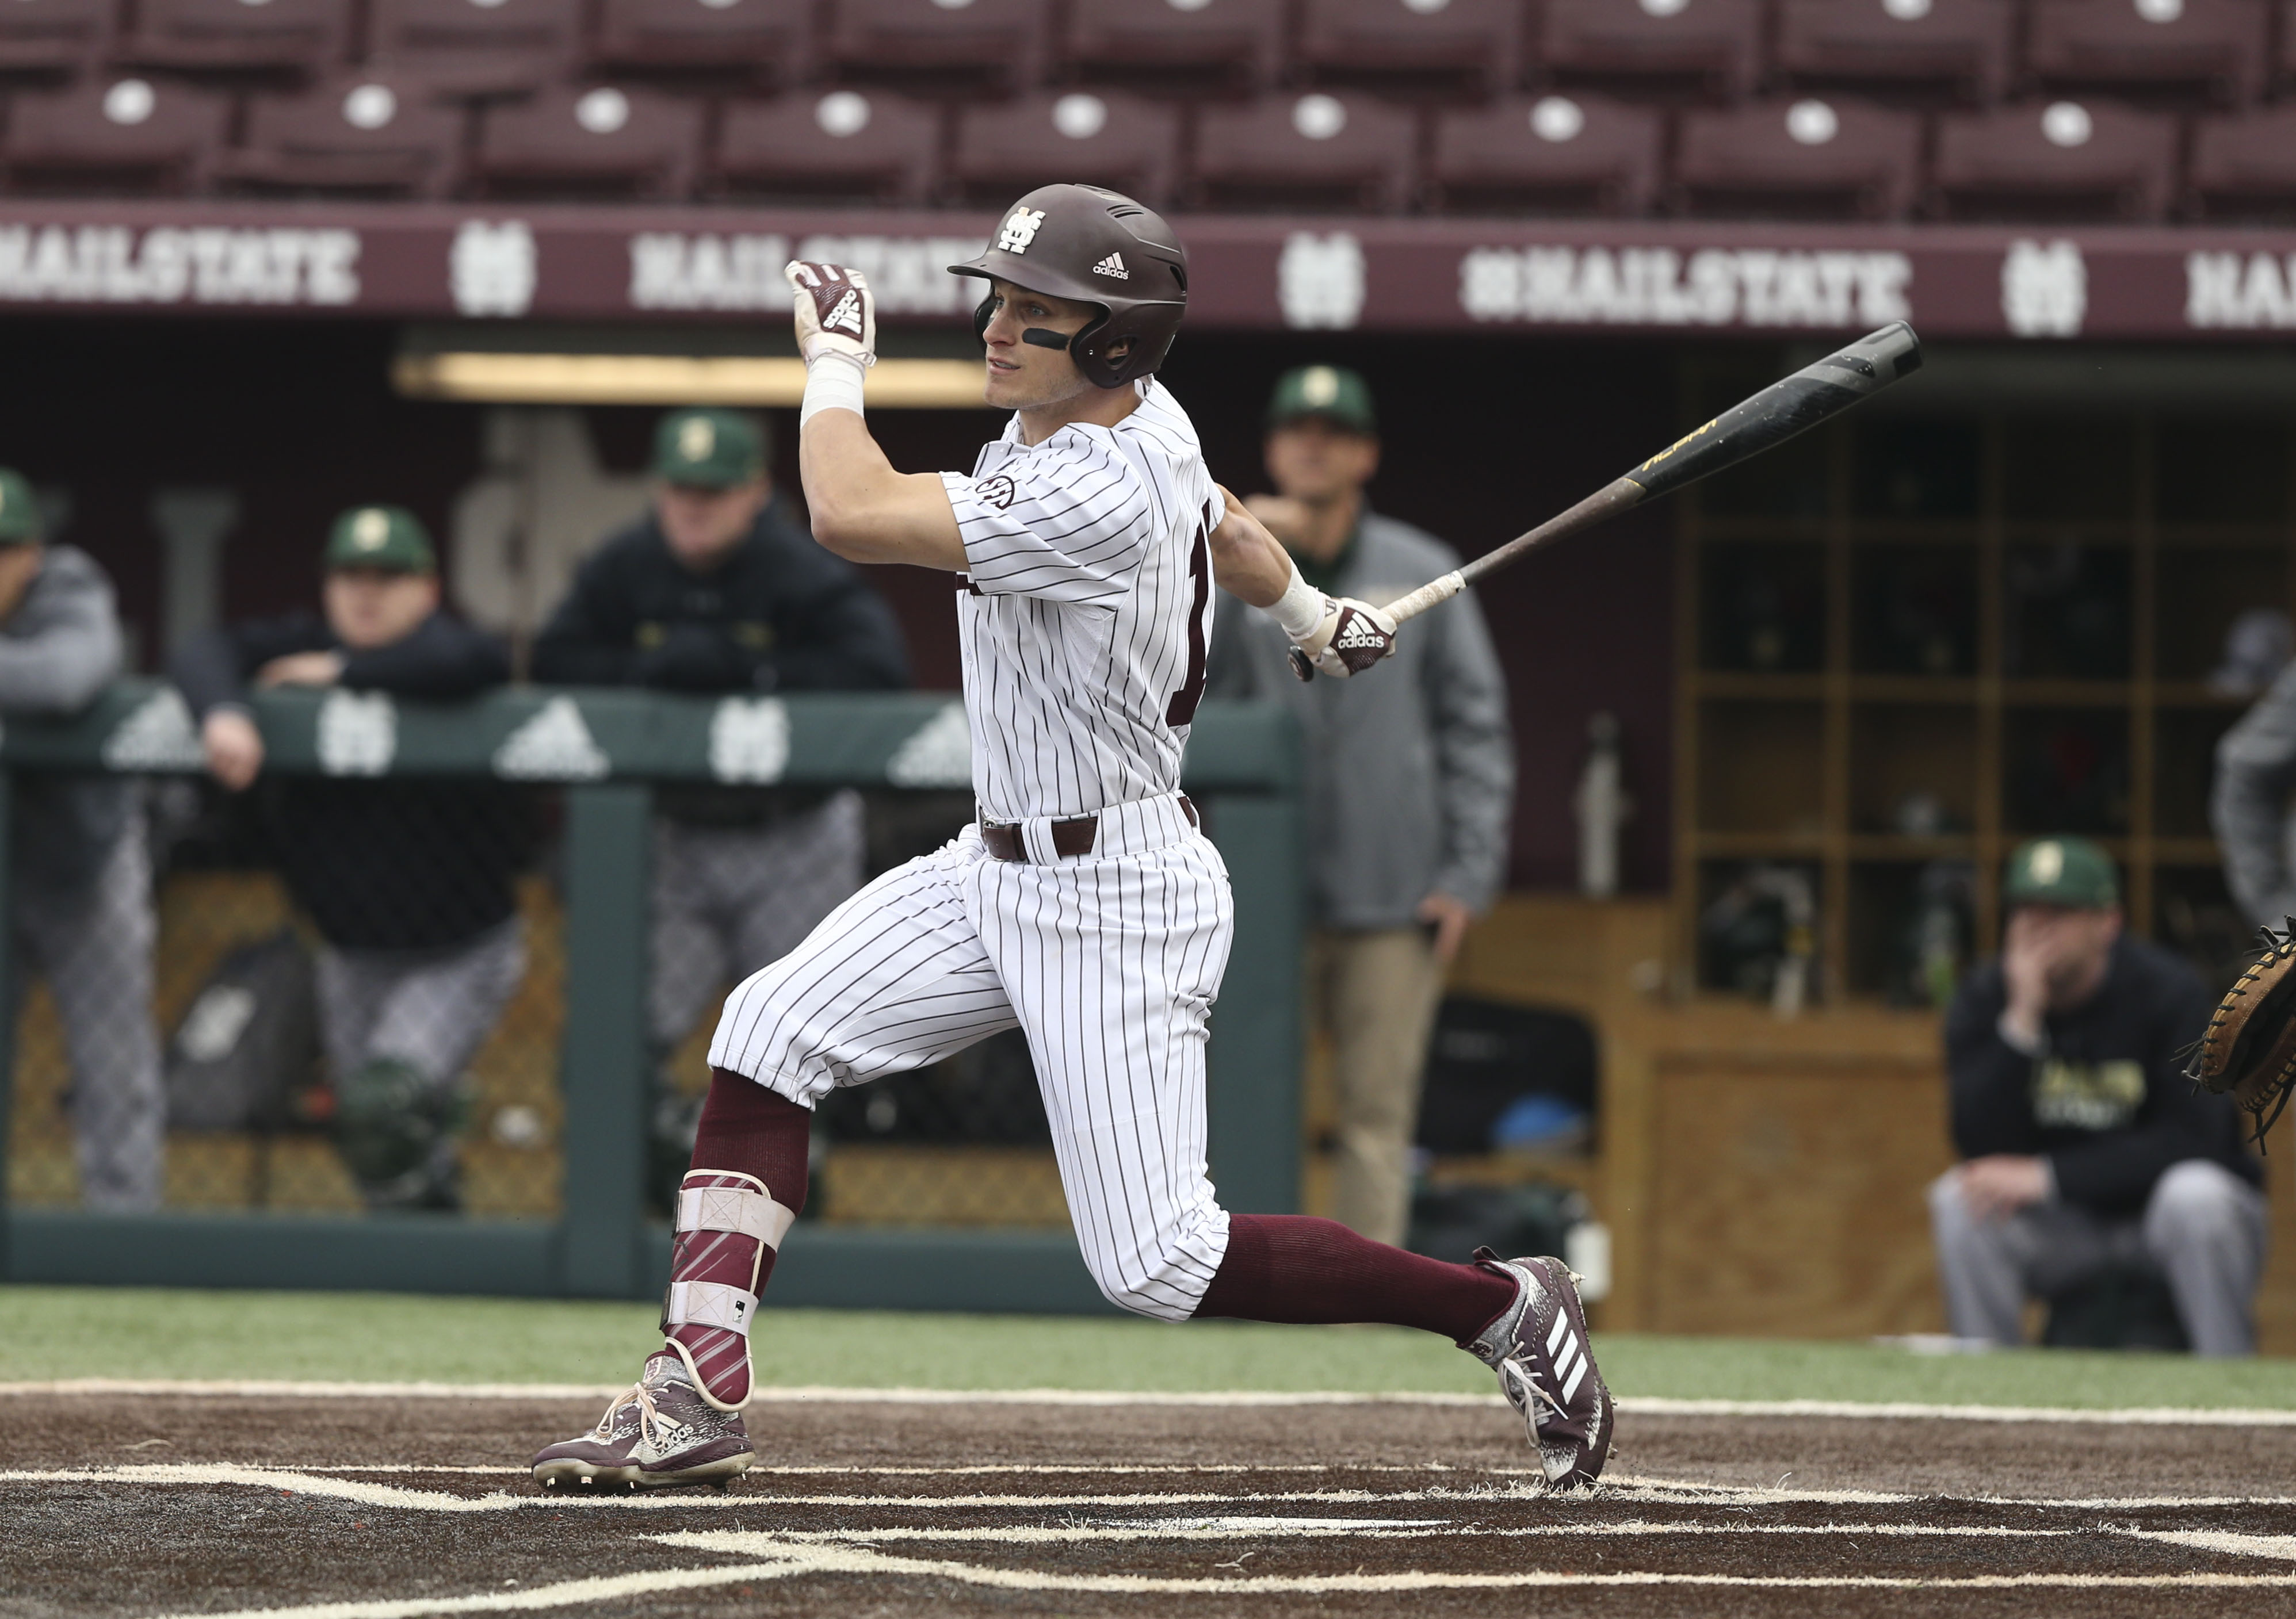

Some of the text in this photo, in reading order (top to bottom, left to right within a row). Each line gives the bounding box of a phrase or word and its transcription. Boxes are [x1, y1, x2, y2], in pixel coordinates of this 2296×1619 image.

[1093, 265, 1129, 280] adidas
[823, 289, 857, 329] adidas
[1338, 634, 1385, 649] adidas
